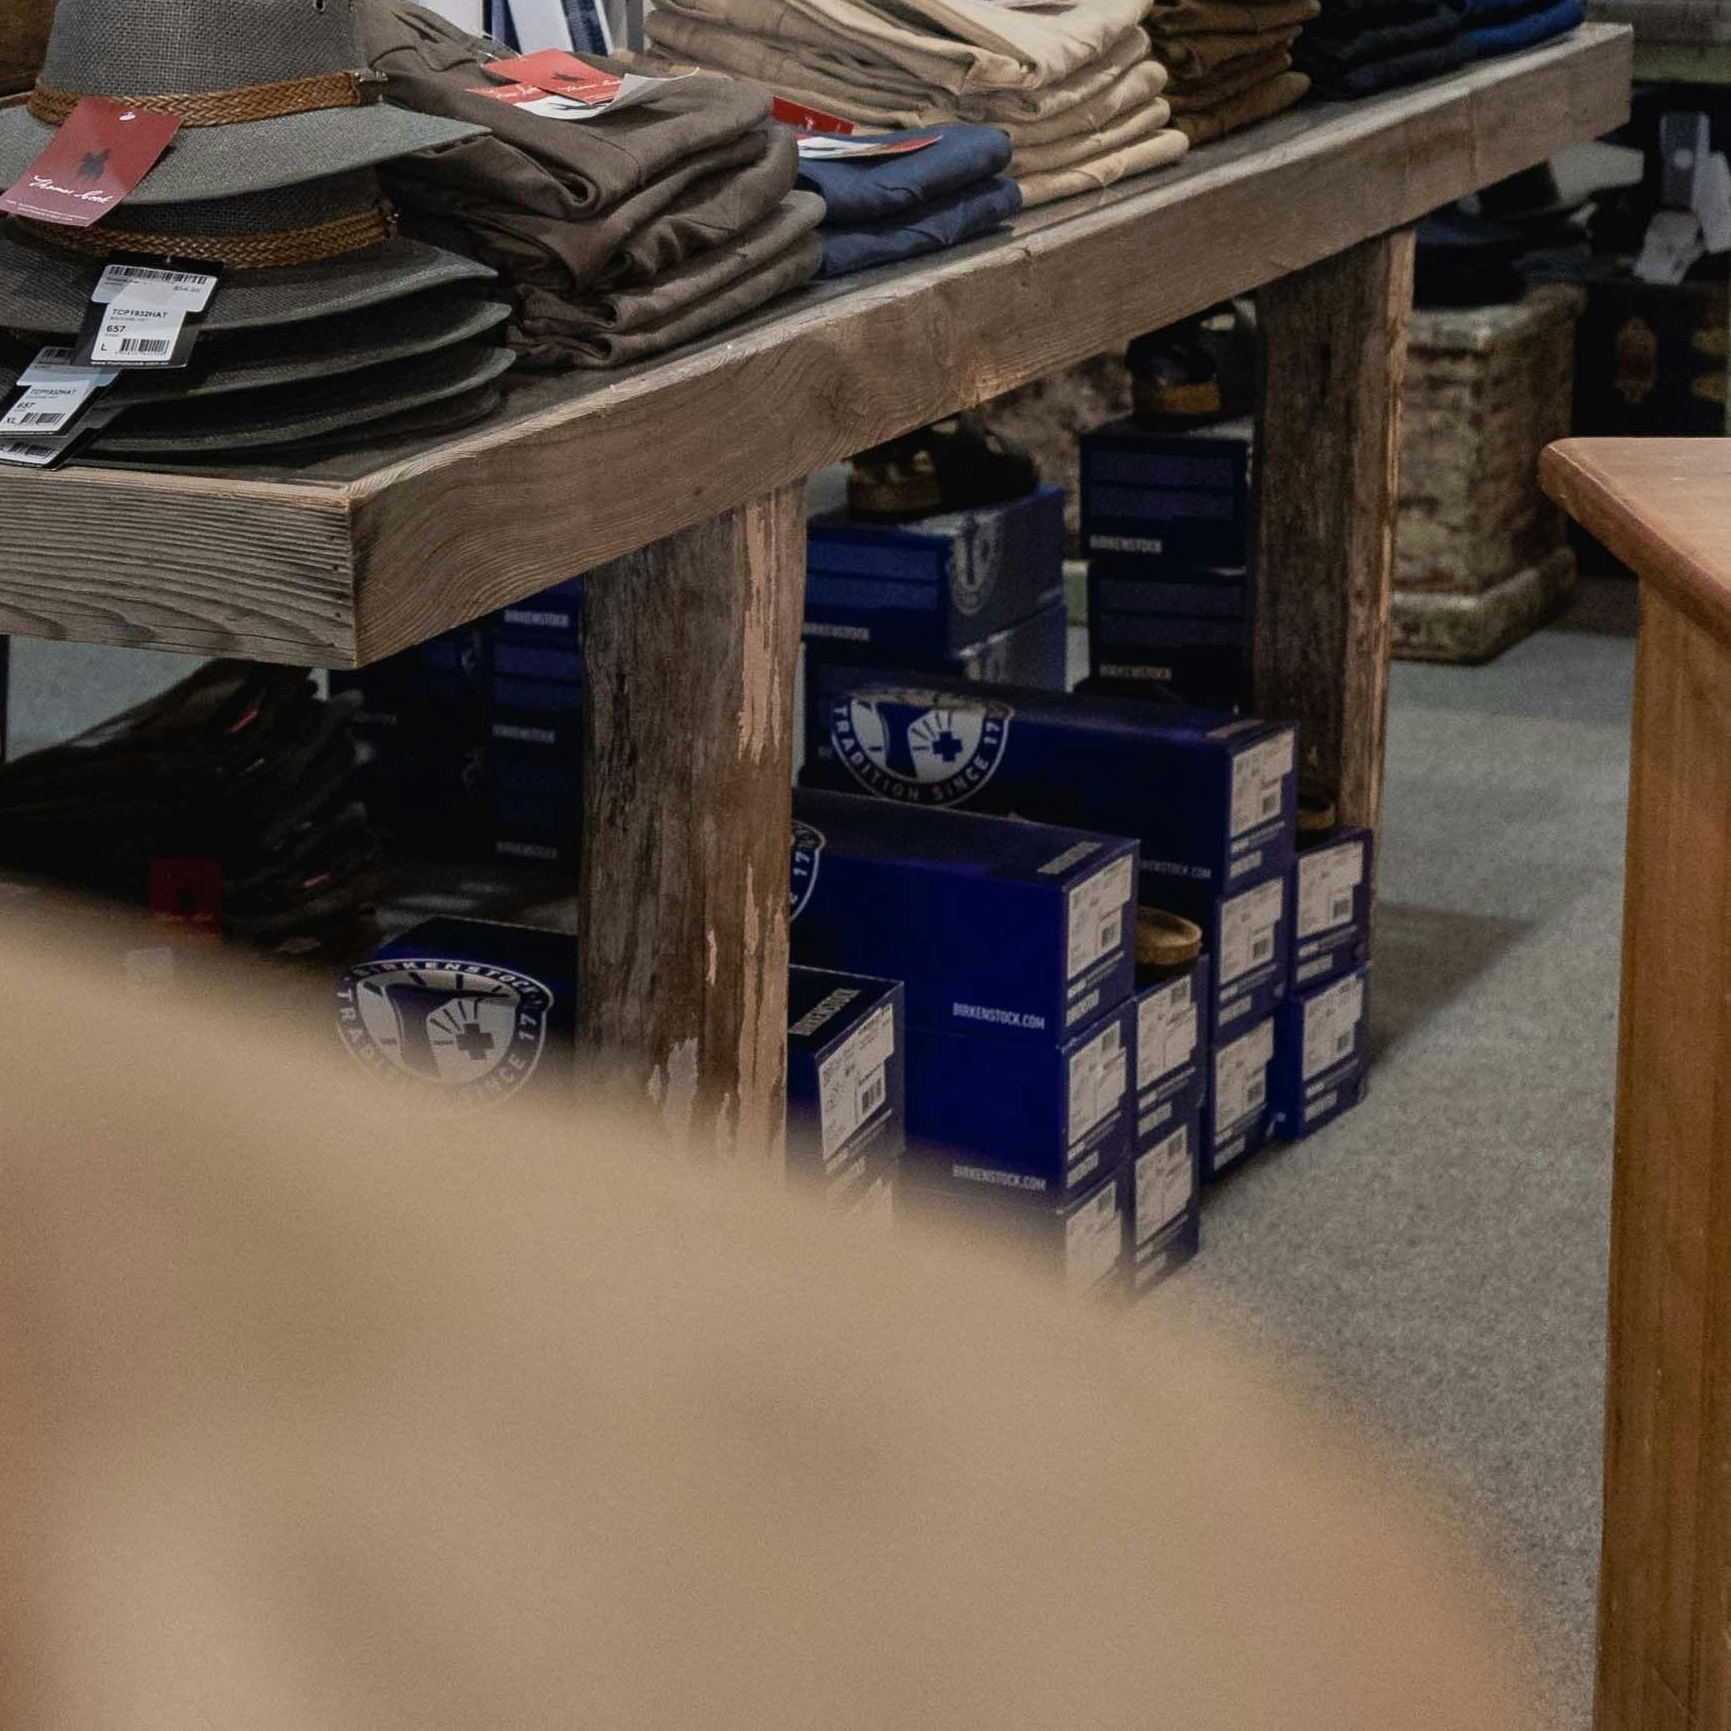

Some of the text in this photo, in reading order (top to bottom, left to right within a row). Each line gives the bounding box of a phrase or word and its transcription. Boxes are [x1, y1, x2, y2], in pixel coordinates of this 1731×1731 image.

[106, 324, 126, 334] 657
[101, 343, 108, 351] L
[833, 705, 919, 801] TRADITION
[932, 756, 990, 801] SINCE
[953, 1001, 1046, 1030] BIRKENSTOCK.COM
[953, 1164, 1046, 1192] BIRKENSTOCK.COM
